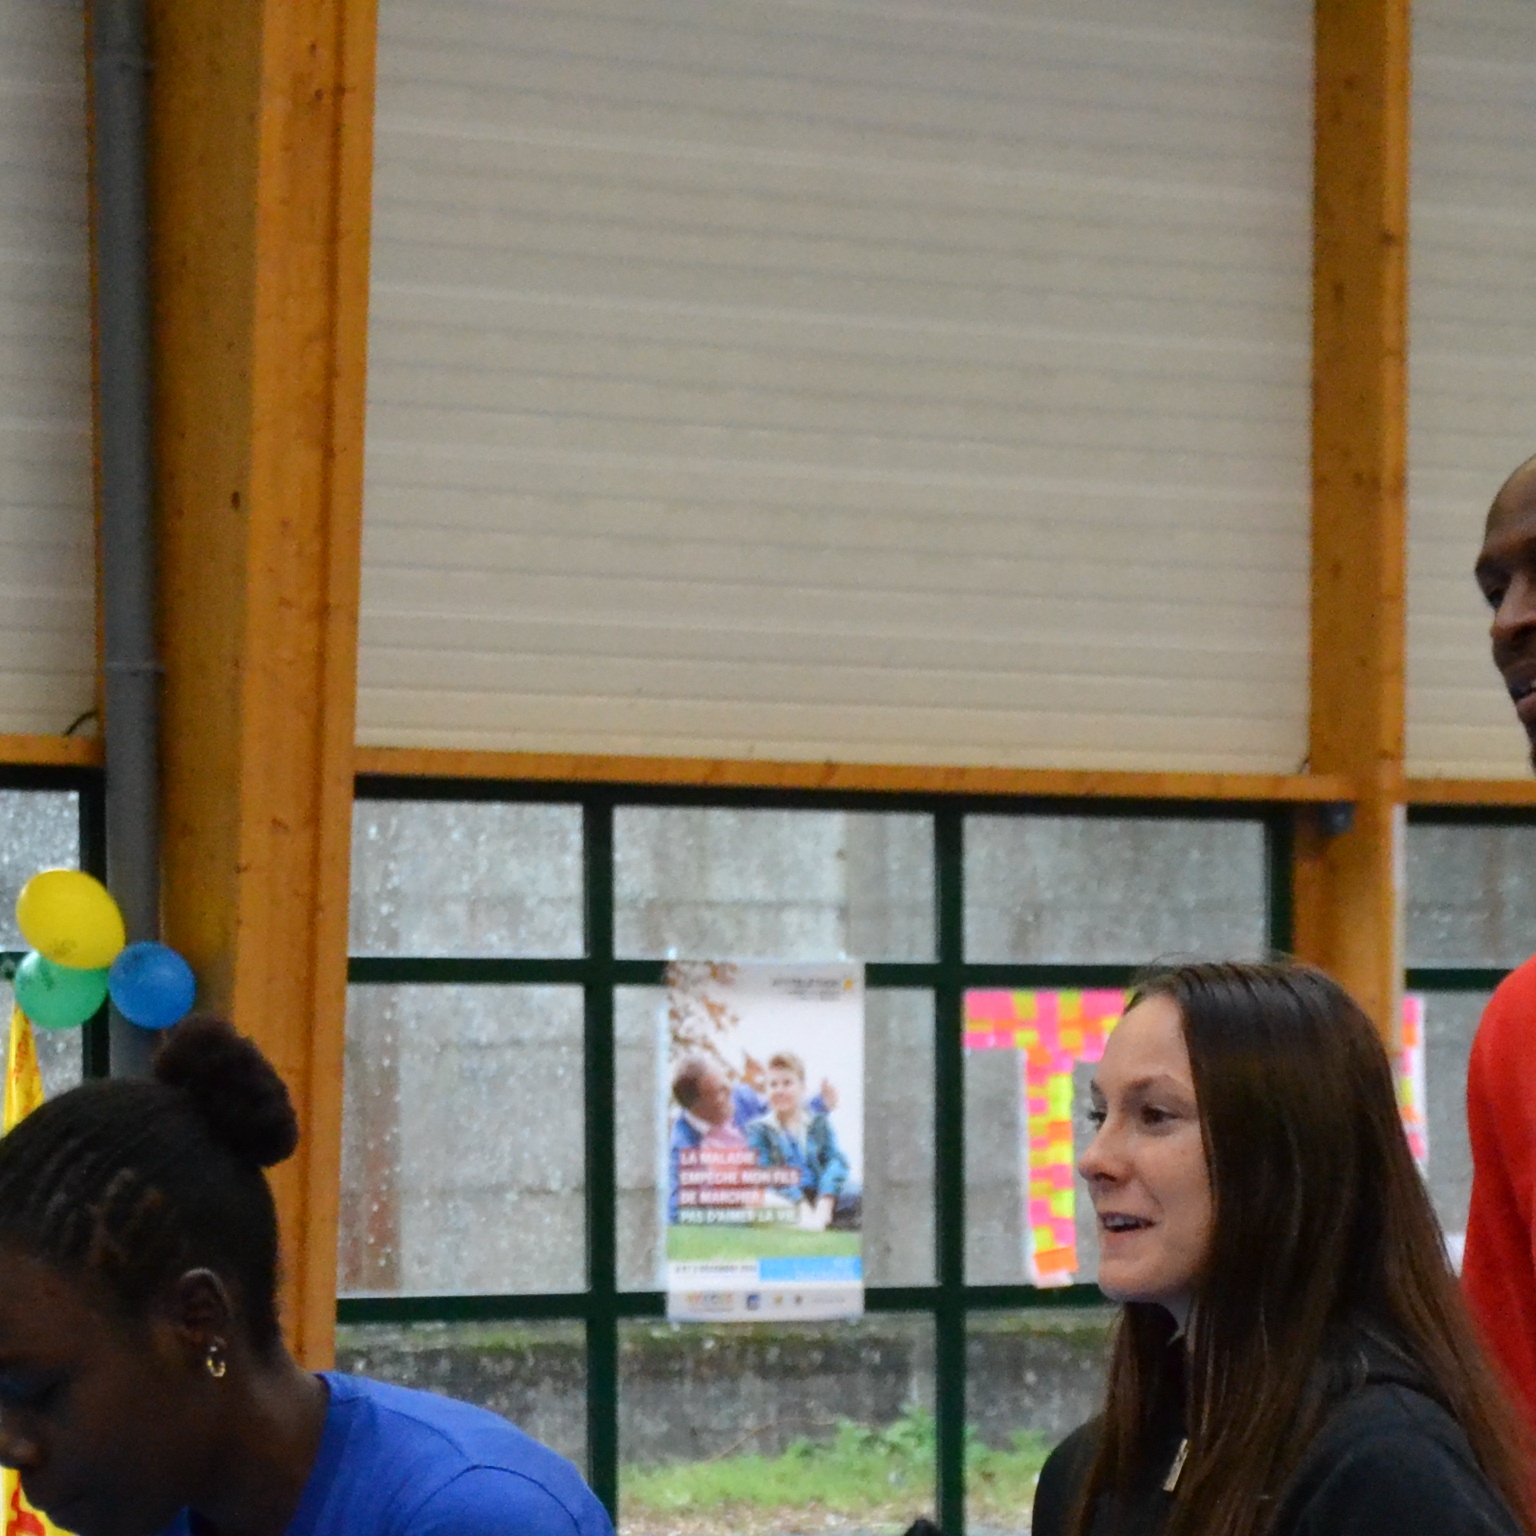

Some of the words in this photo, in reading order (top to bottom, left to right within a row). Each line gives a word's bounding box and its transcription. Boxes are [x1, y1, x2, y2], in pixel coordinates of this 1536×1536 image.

[681, 1150, 698, 1165] LA
[741, 1169, 771, 1185] MON
[773, 1169, 801, 1185] FILS
